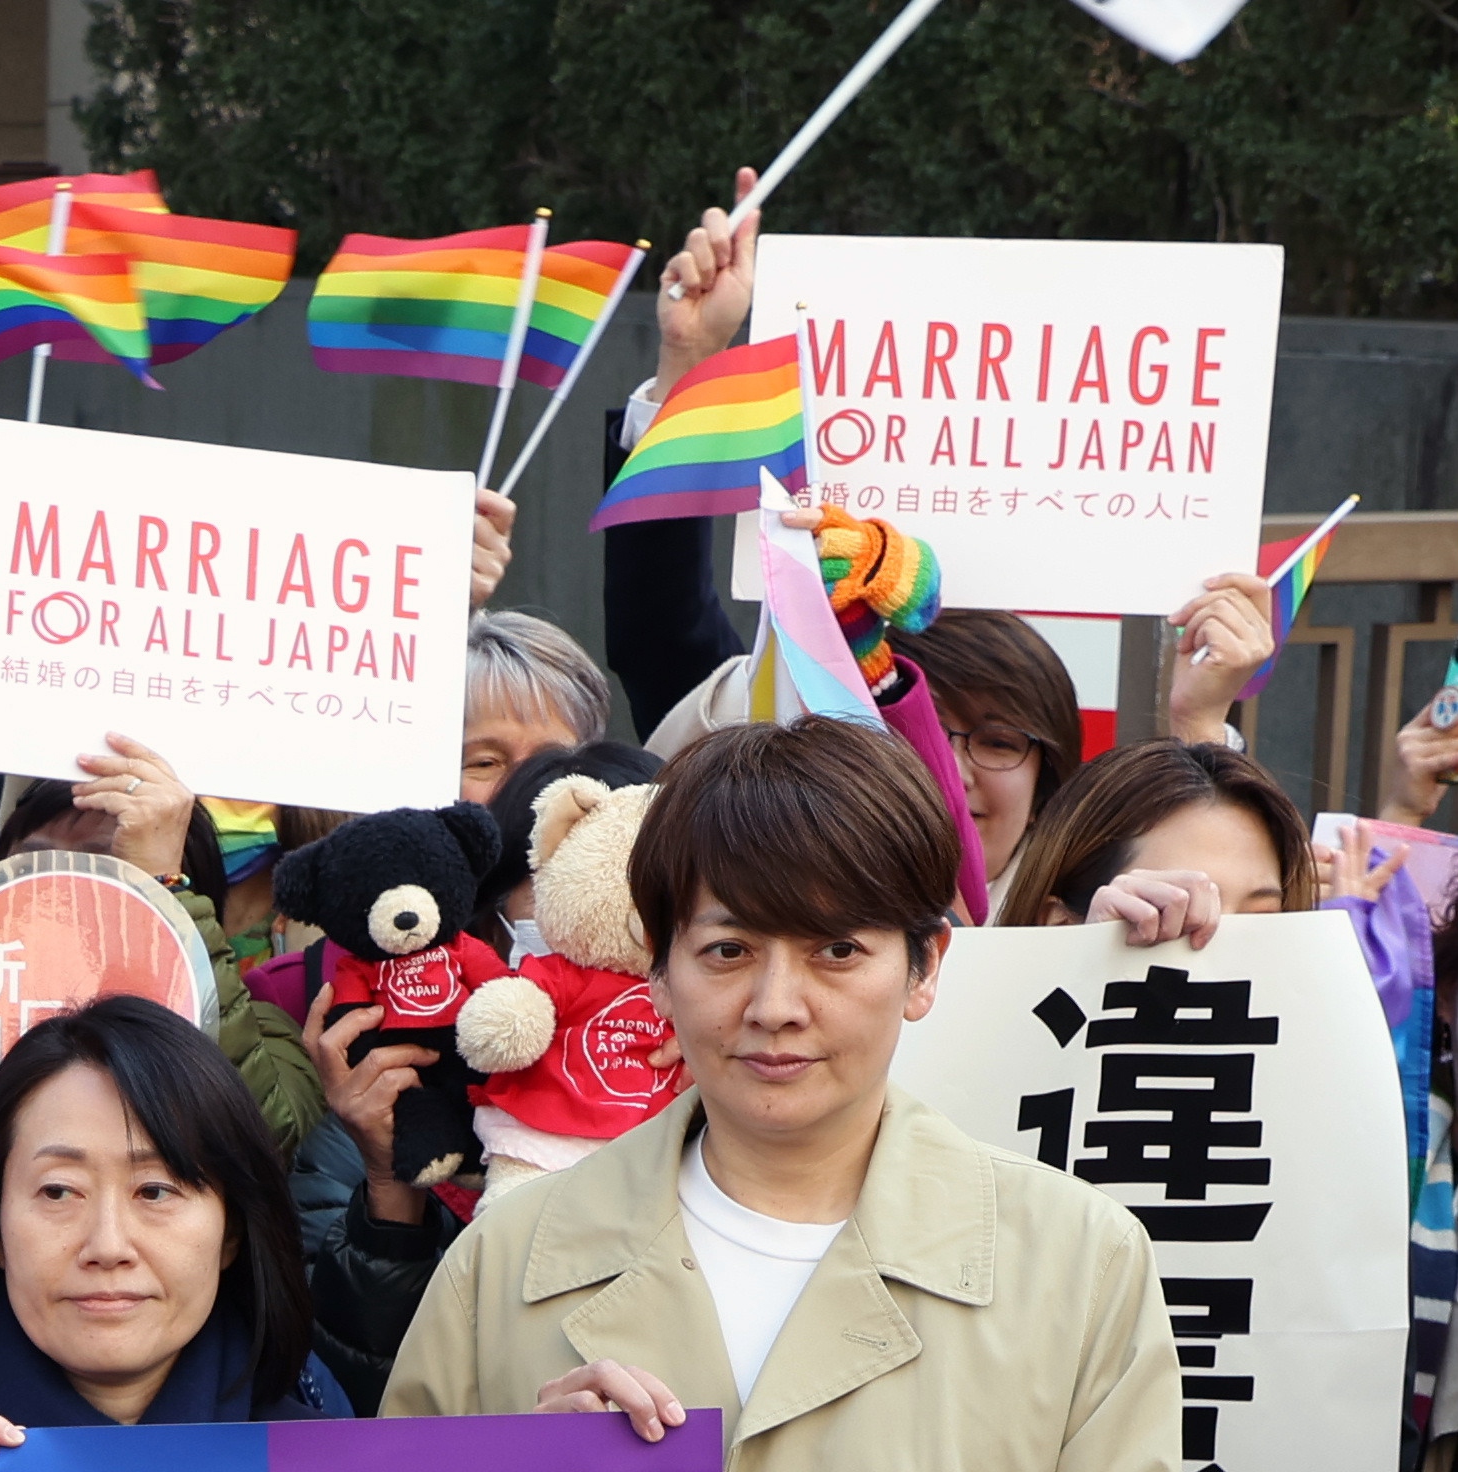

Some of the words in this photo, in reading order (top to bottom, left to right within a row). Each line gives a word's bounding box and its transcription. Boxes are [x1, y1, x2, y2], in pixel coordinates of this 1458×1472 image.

[806, 318, 1226, 406] MARRIAGE
[816, 408, 906, 466] OR
[930, 415, 1023, 468] ALL
[1047, 418, 1217, 474] JAPAN
[9, 501, 423, 620] MARRIAGE
[5, 590, 121, 647] FOR
[144, 606, 234, 661] ALL
[258, 617, 417, 682] JAPAN
[0, 655, 414, 725] 結婚の自由をすべての人に
[396, 975, 423, 987] ALL
[398, 985, 440, 998] JAPAN
